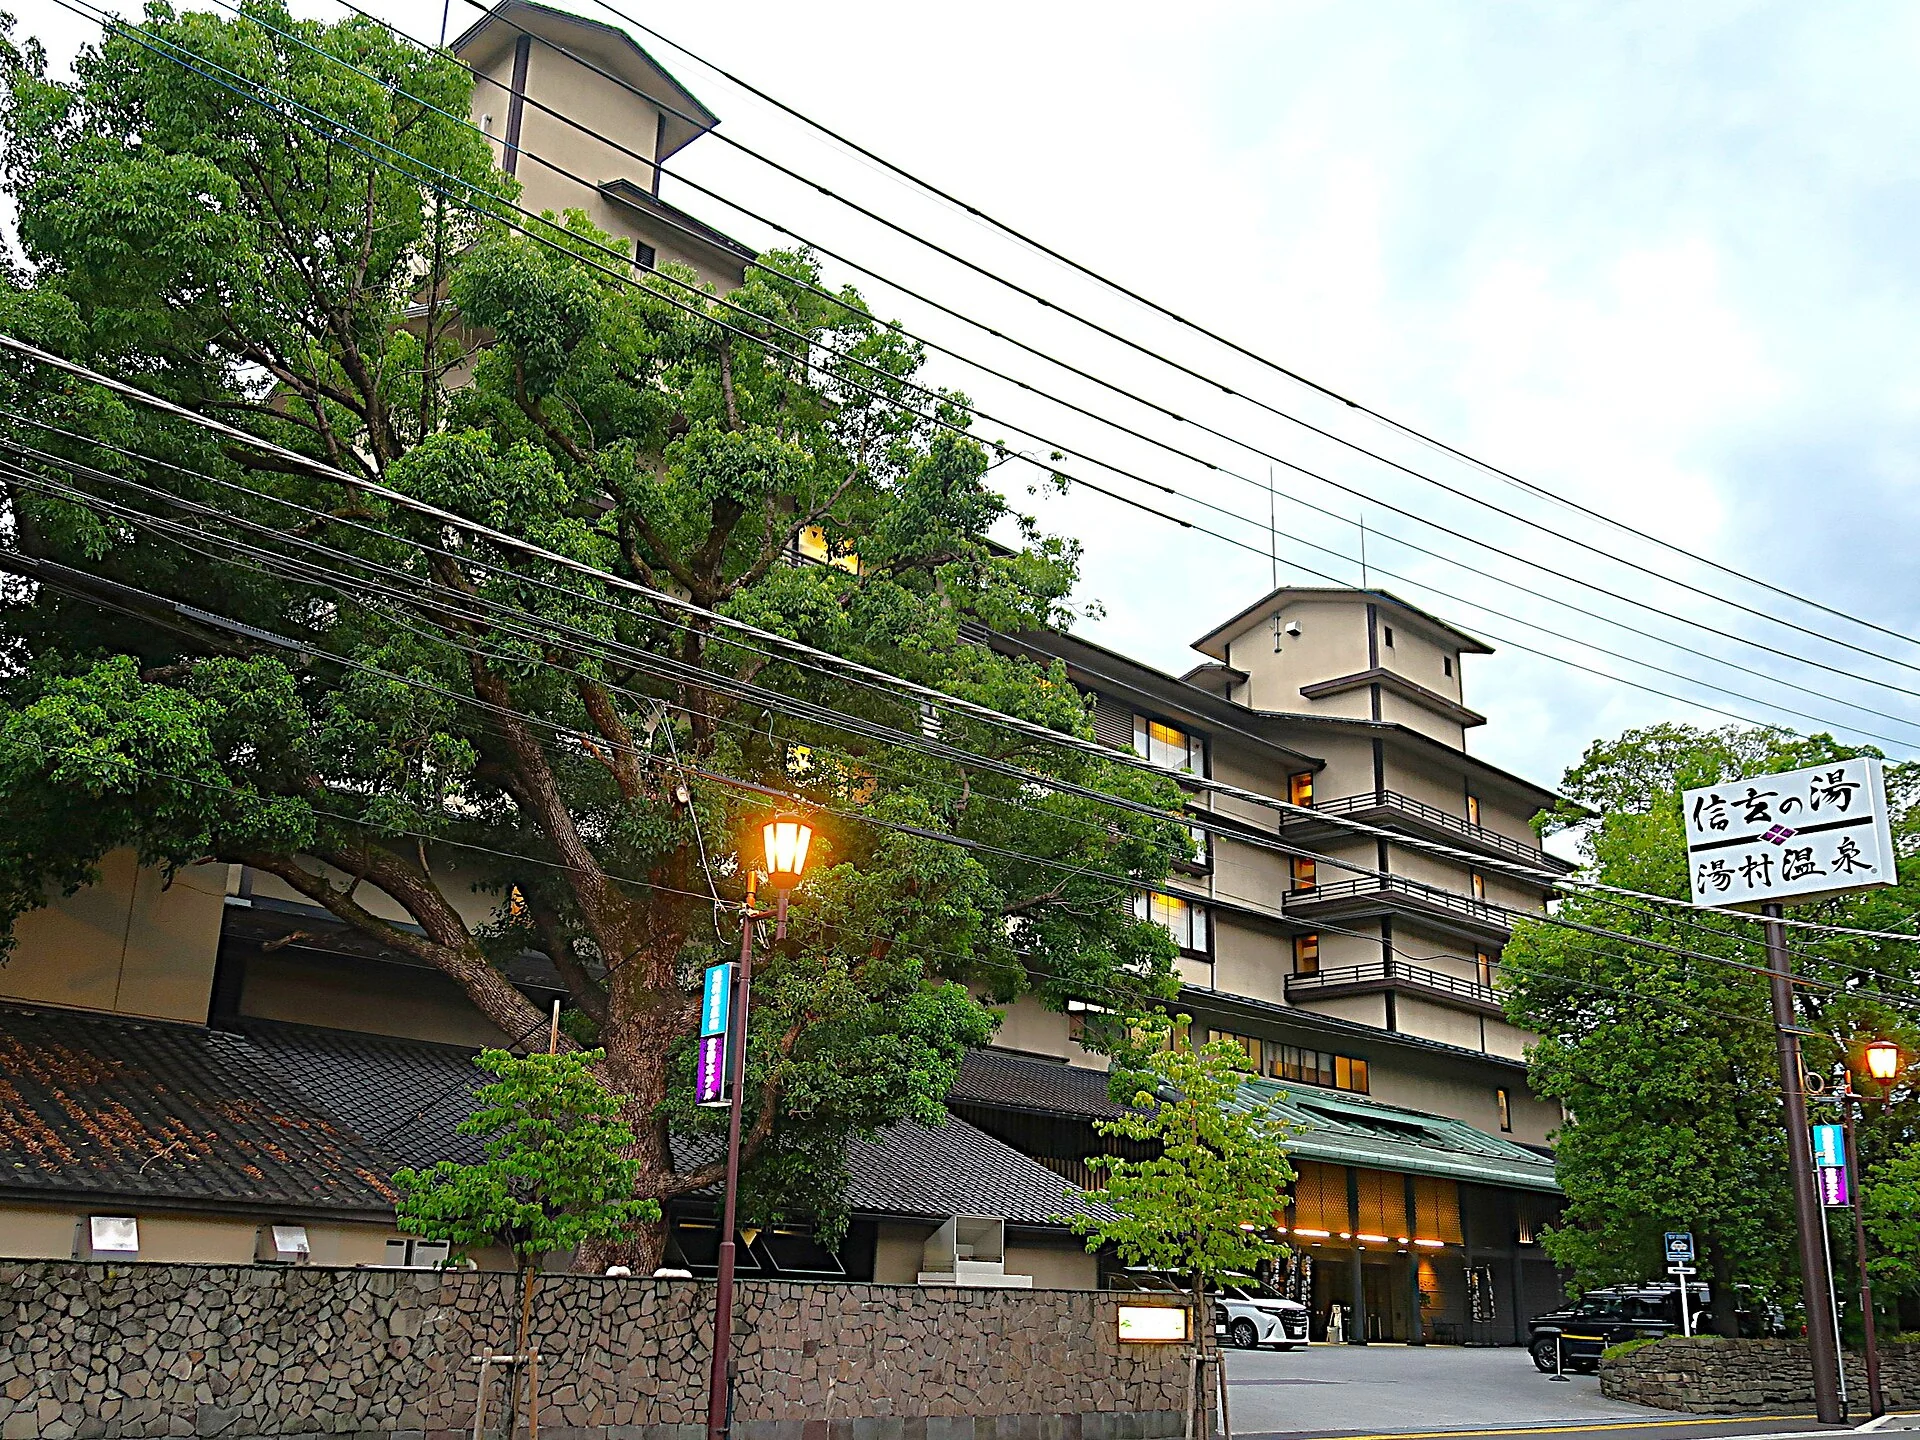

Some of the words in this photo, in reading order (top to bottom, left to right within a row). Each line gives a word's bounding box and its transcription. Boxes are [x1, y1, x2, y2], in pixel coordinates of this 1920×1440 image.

[1693, 768, 1861, 832] 信玄の湯
[1697, 836, 1873, 894] 湯村温泉
